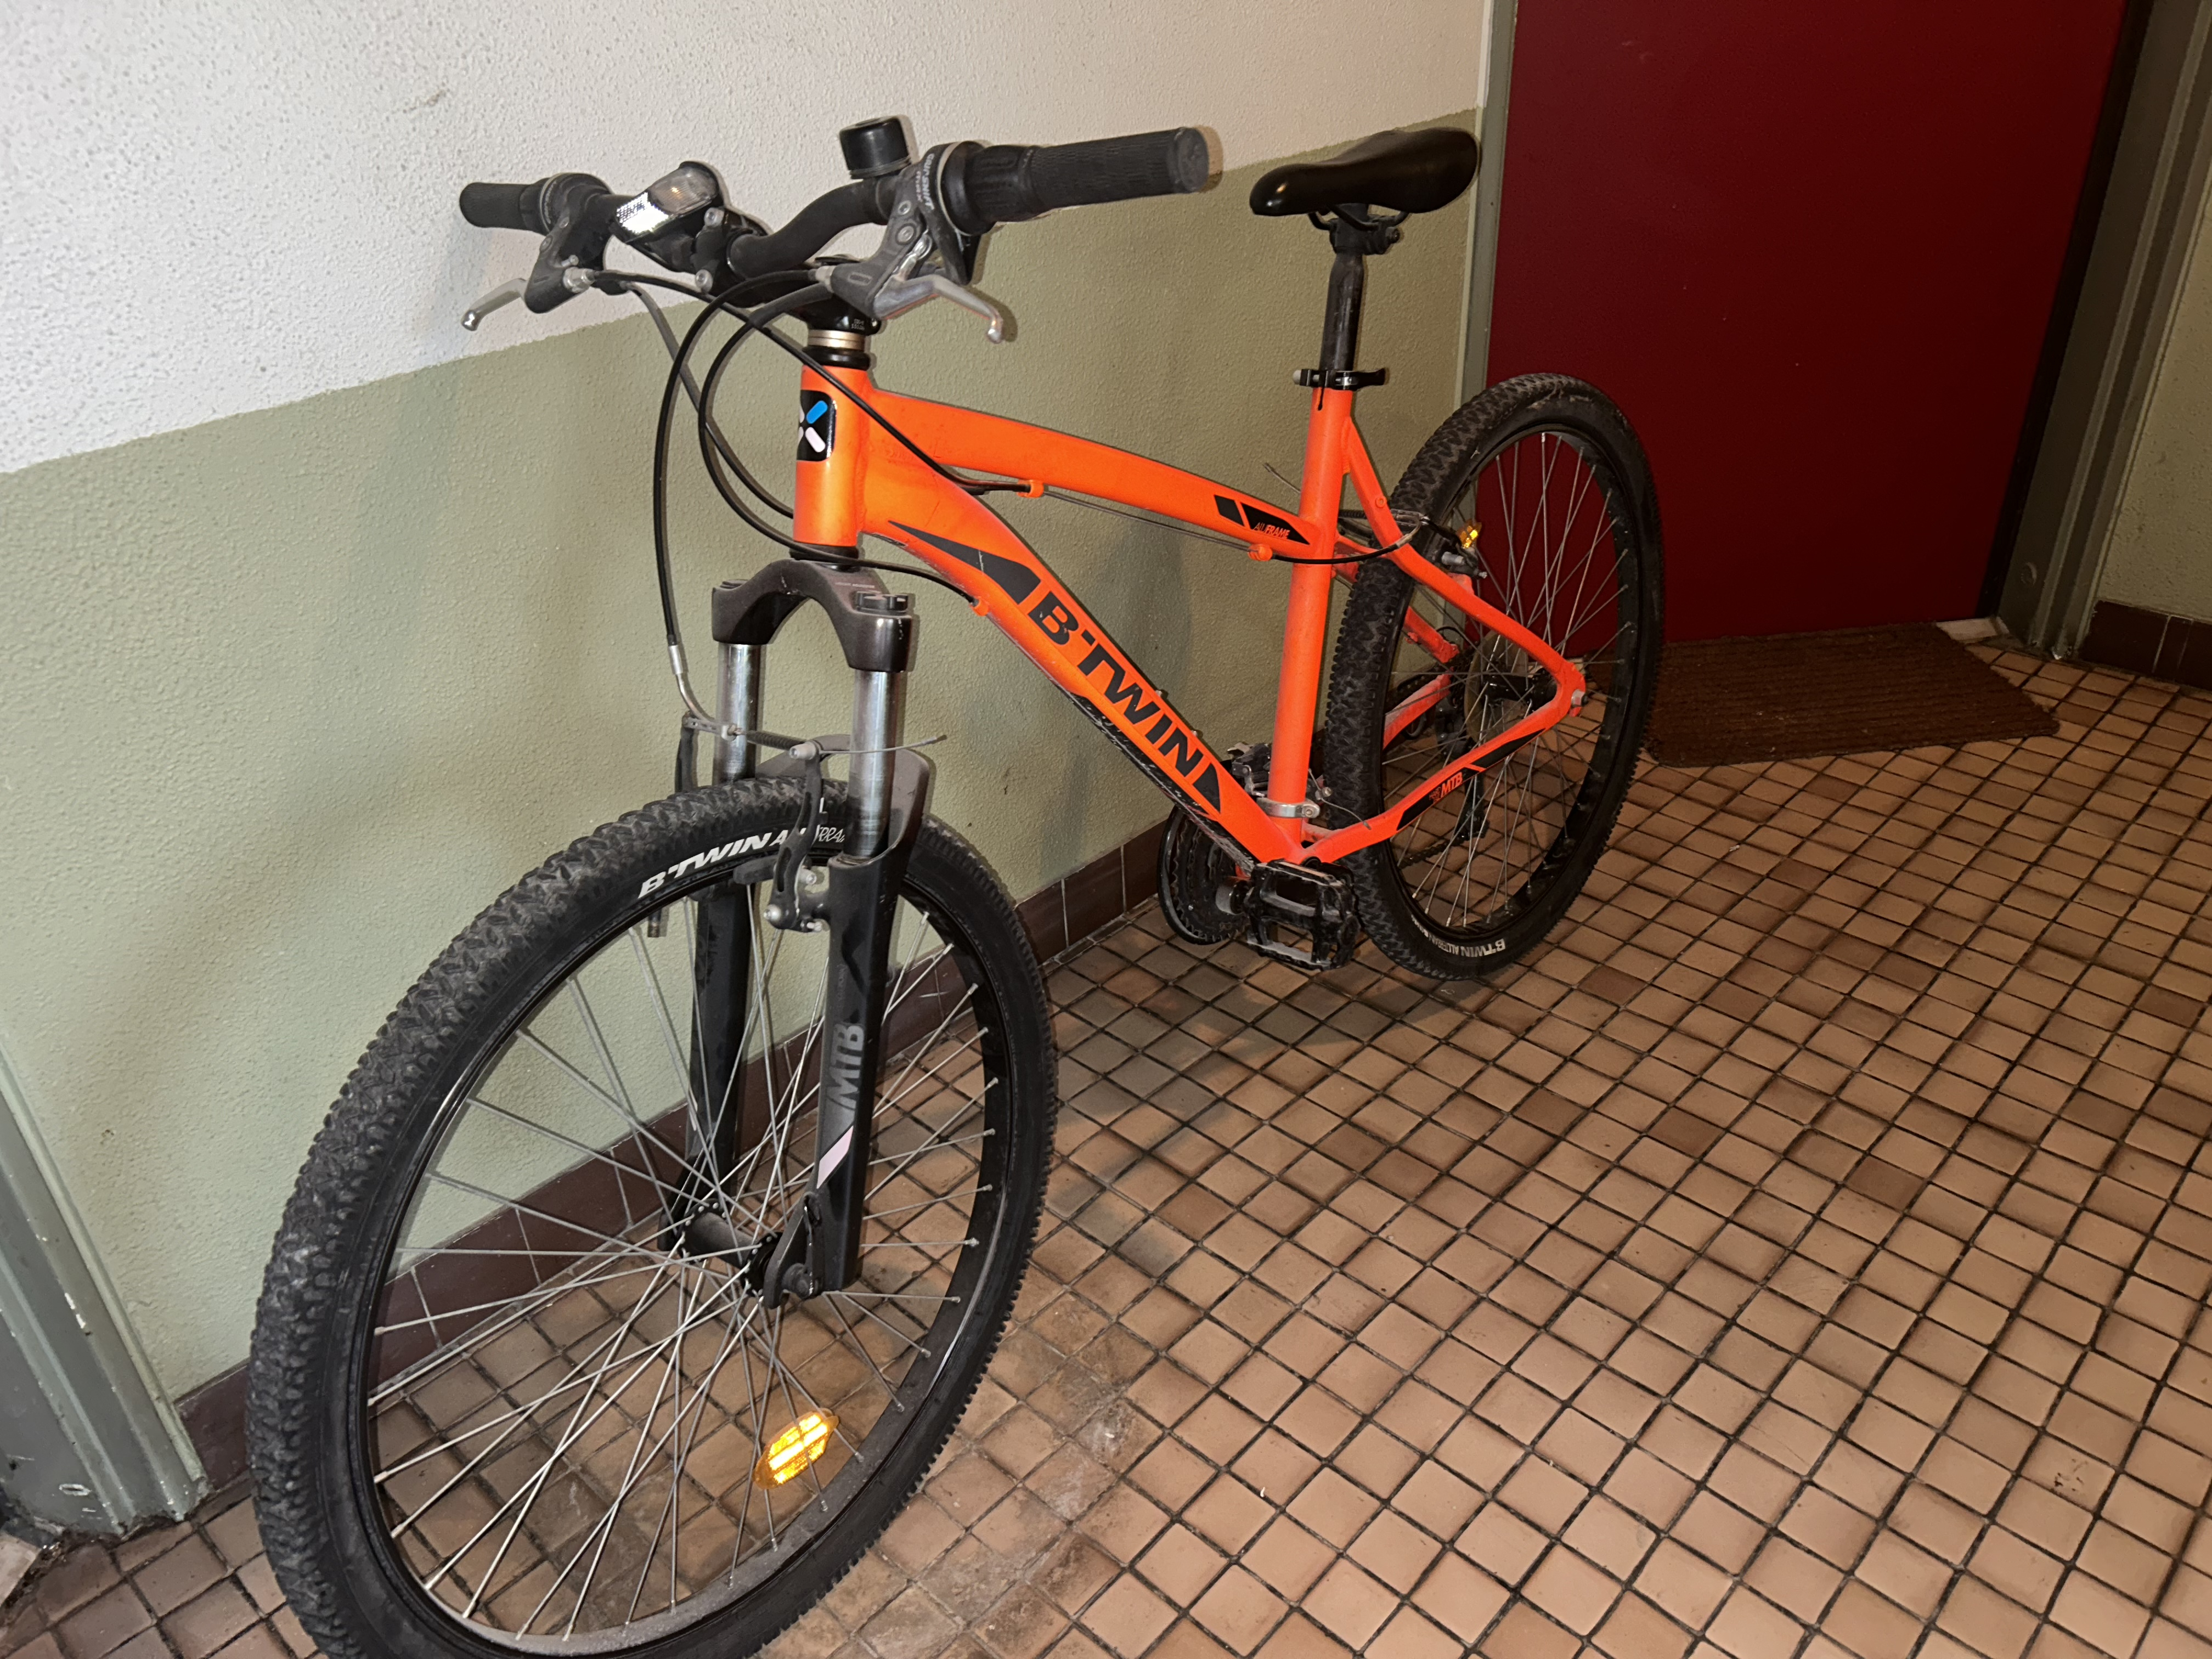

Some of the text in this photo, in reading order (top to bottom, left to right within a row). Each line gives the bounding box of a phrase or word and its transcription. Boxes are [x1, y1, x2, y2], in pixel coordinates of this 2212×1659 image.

[1028, 590, 1204, 777] B'TWIN
[1441, 771, 1463, 799] MTB
[827, 1023, 865, 1110] MTB
